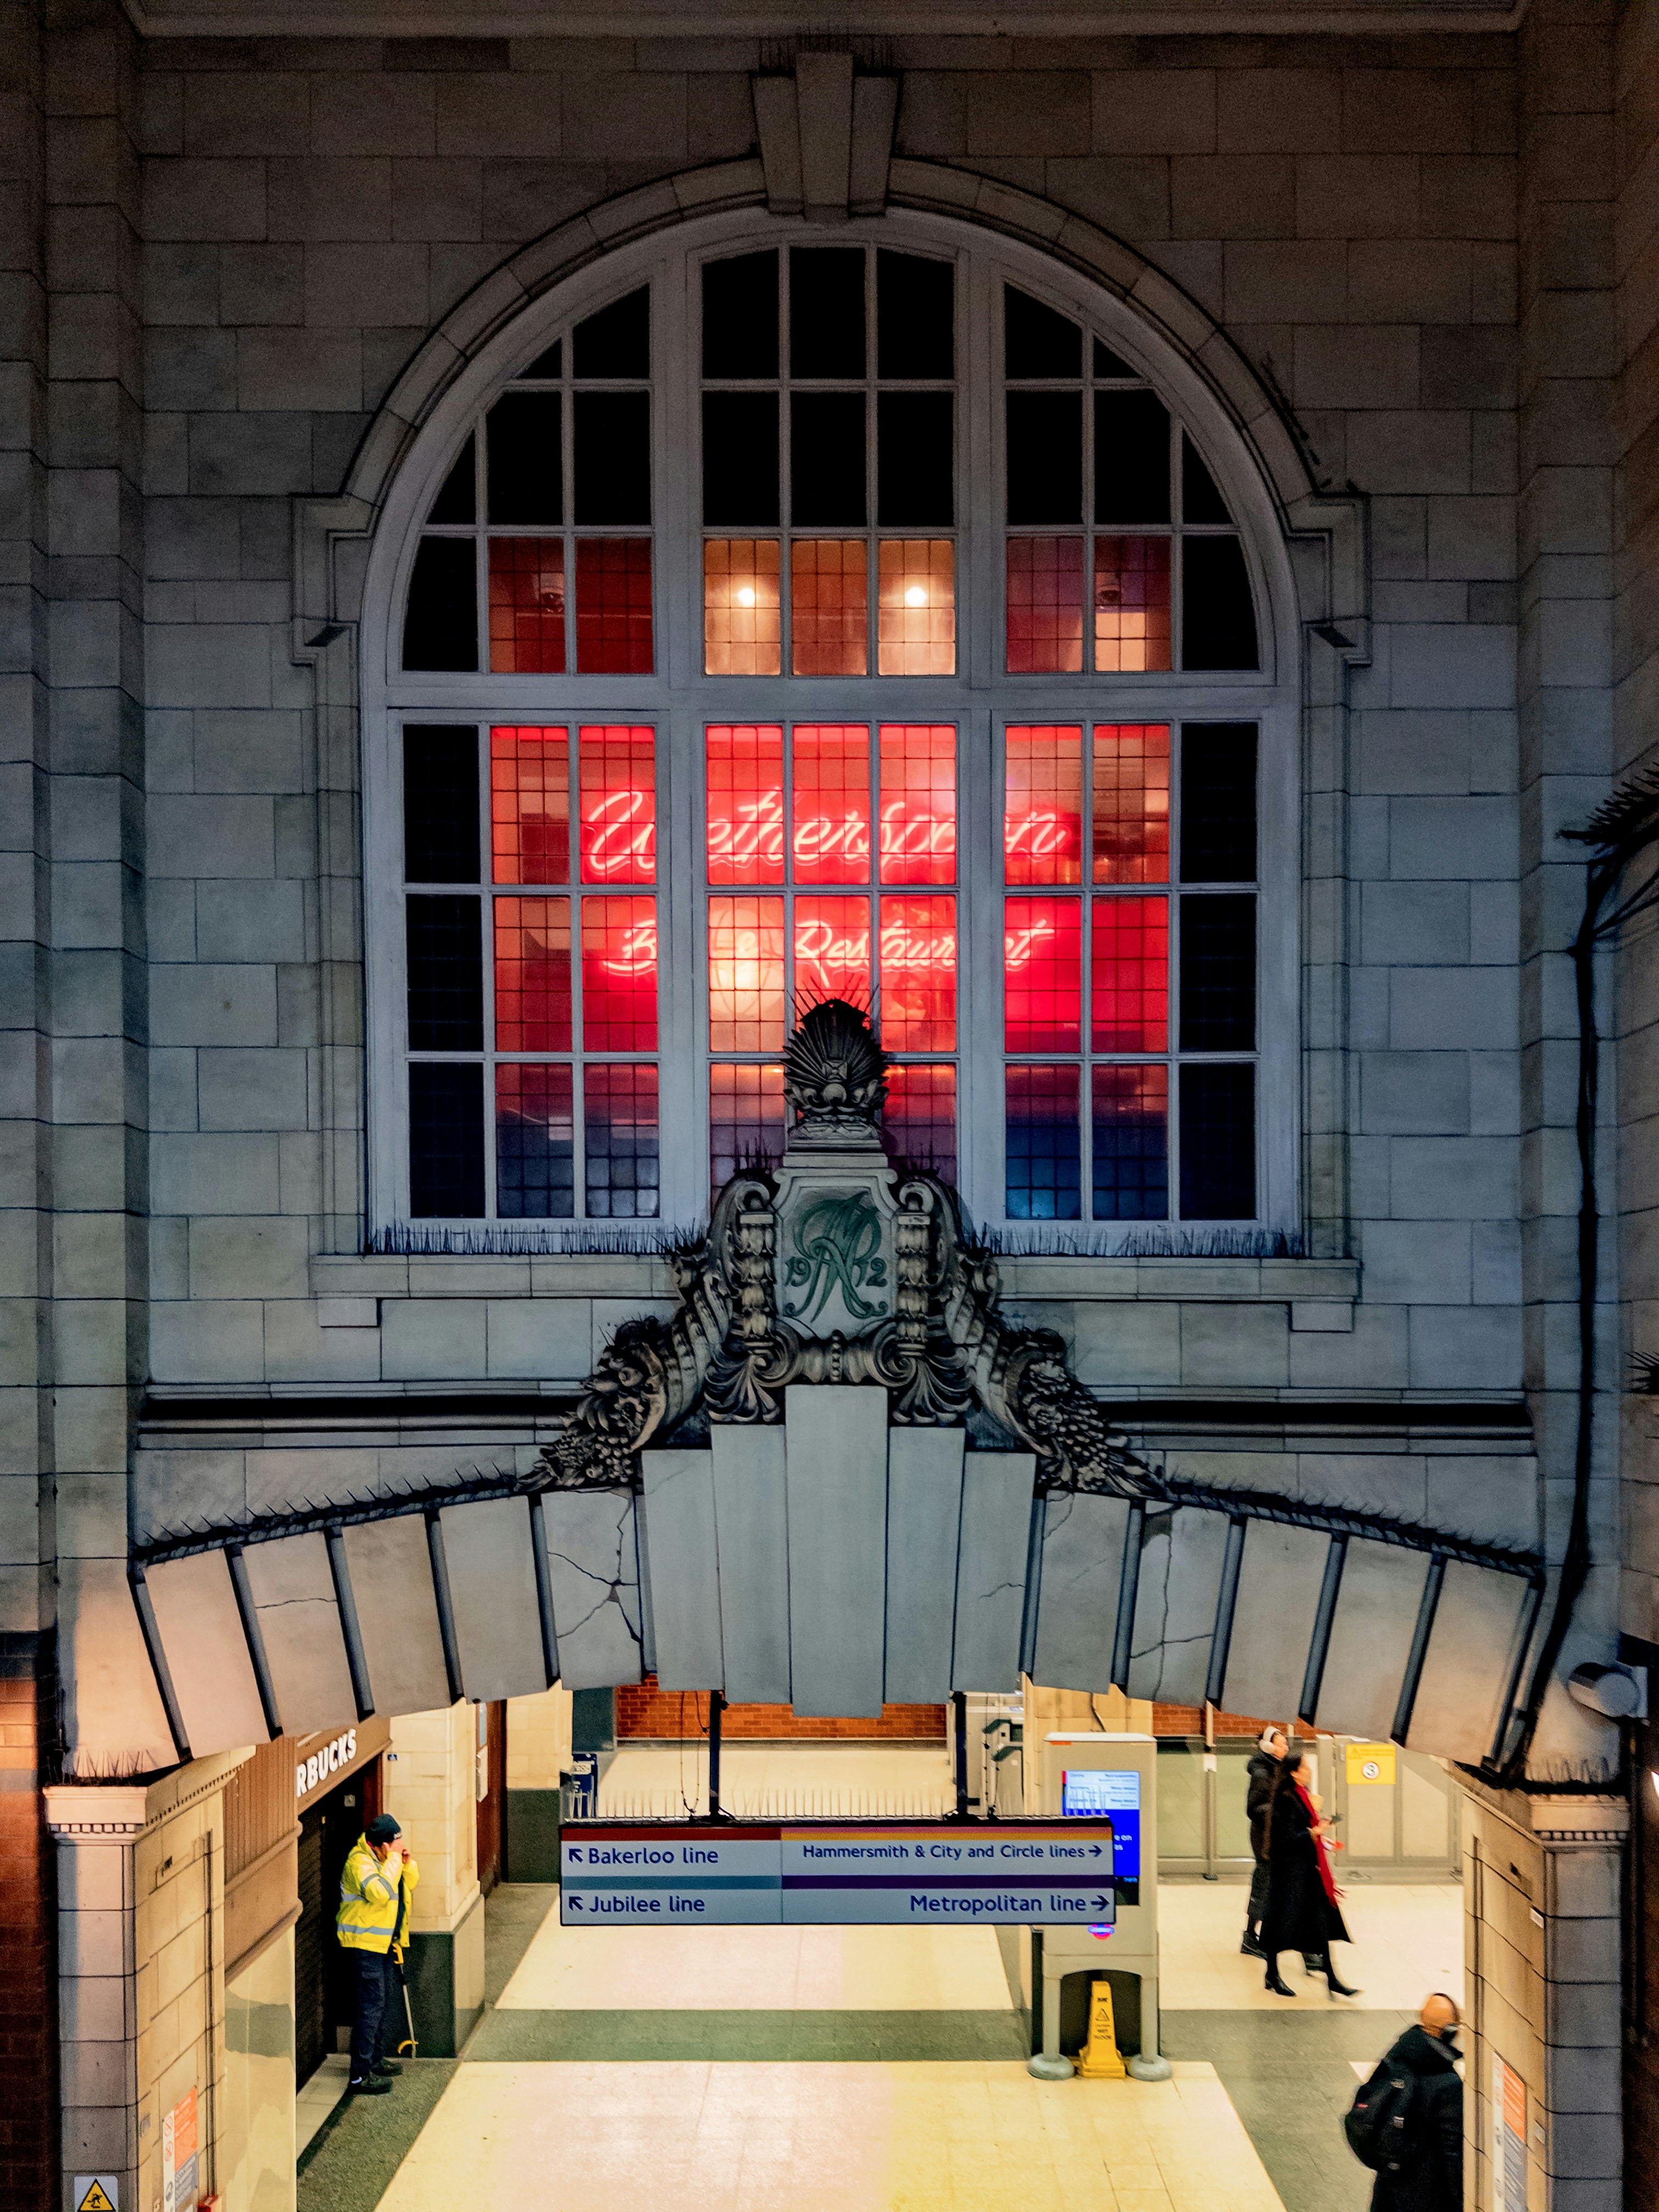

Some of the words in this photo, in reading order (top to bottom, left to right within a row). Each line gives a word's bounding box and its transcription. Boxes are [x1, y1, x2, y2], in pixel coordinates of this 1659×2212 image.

[296, 1728, 357, 1798] RBUCKS
[589, 1848, 674, 1864] Bakerloo
[683, 1848, 719, 1864] line
[803, 1844, 909, 1858] Hammersmith
[915, 1844, 926, 1858] &
[931, 1844, 962, 1860] City
[968, 1844, 994, 1858] and
[1001, 1844, 1044, 1858] Circle
[1049, 1844, 1085, 1858] lines
[589, 1896, 661, 1912] Jubilee
[669, 1896, 705, 1912] line
[911, 1894, 1042, 1915] Metropolitan
[1051, 1894, 1087, 1912] line
